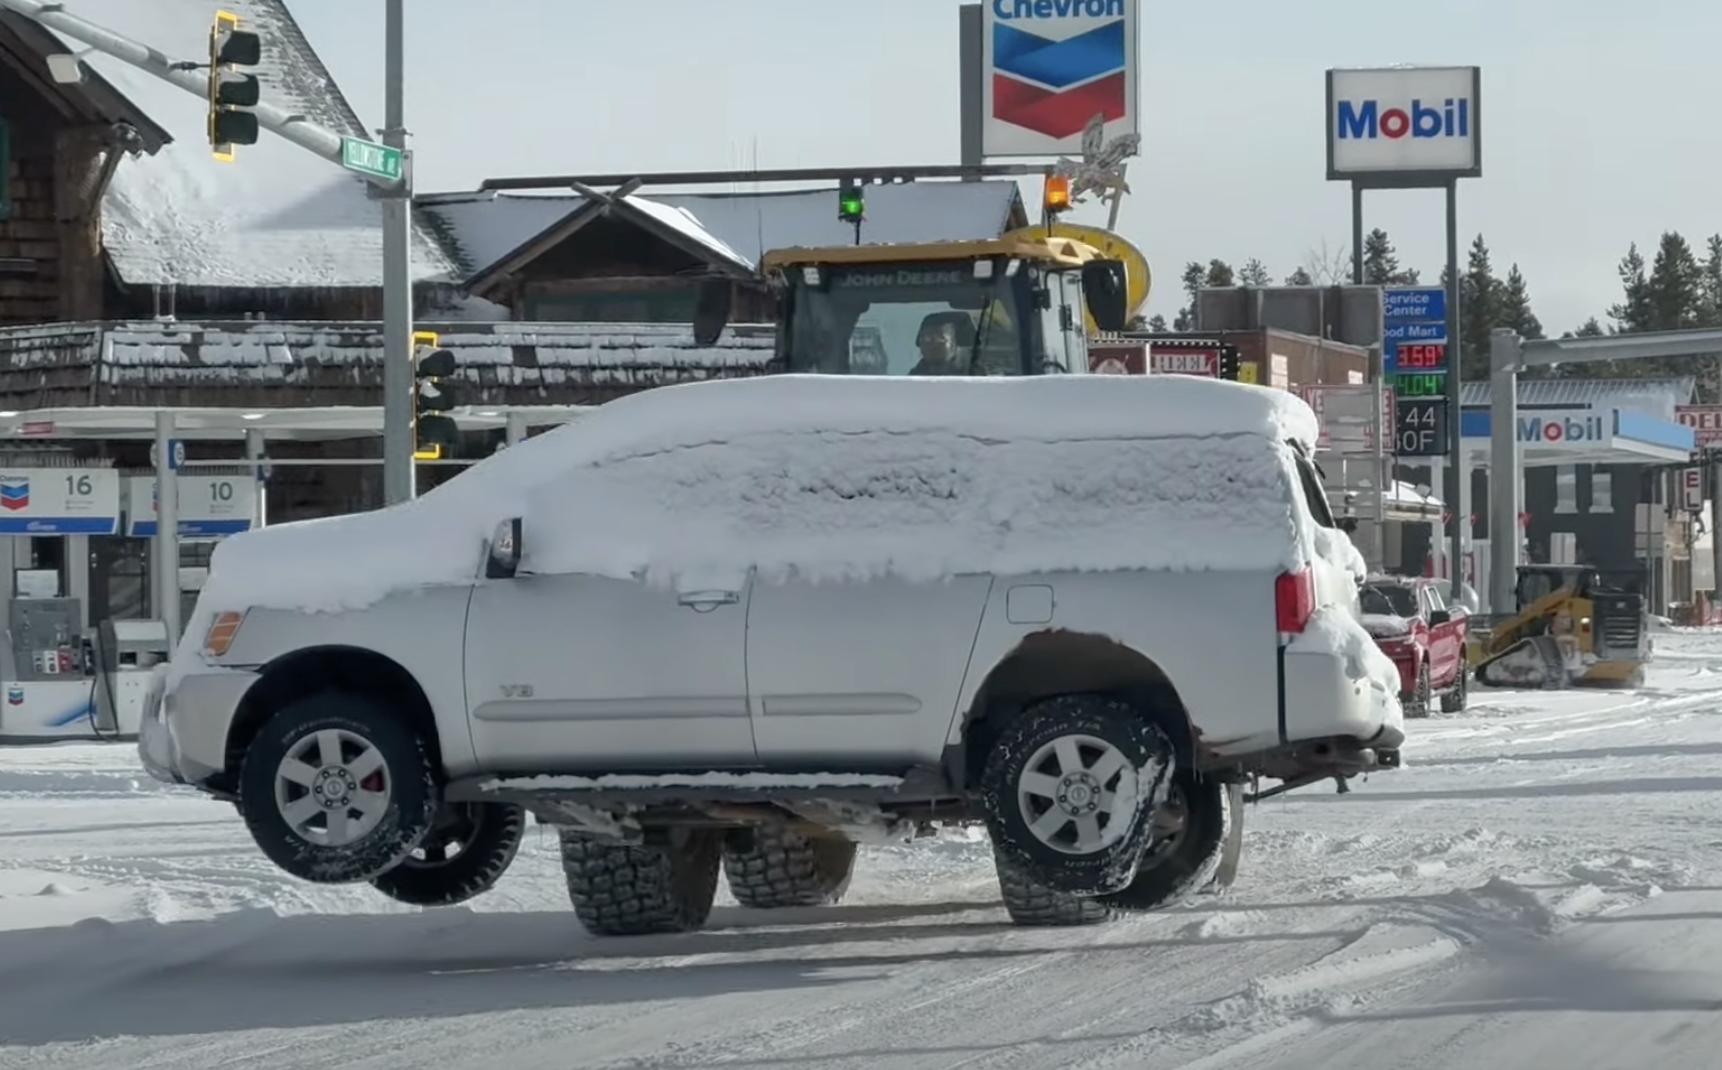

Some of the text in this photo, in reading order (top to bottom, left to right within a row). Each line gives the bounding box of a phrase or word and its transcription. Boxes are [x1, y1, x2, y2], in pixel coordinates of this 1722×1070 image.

[993, 0, 1124, 19] Chevron
[1338, 98, 1468, 139] Mobil
[841, 270, 961, 287] JOHN DEERE
[1382, 292, 1430, 304] Service
[1383, 305, 1427, 316] Center
[1408, 325, 1437, 337] Mart
[1516, 416, 1602, 441] Mobil
[1396, 430, 1434, 452] 0F
[66, 475, 92, 495] 16
[210, 482, 233, 501] 10
